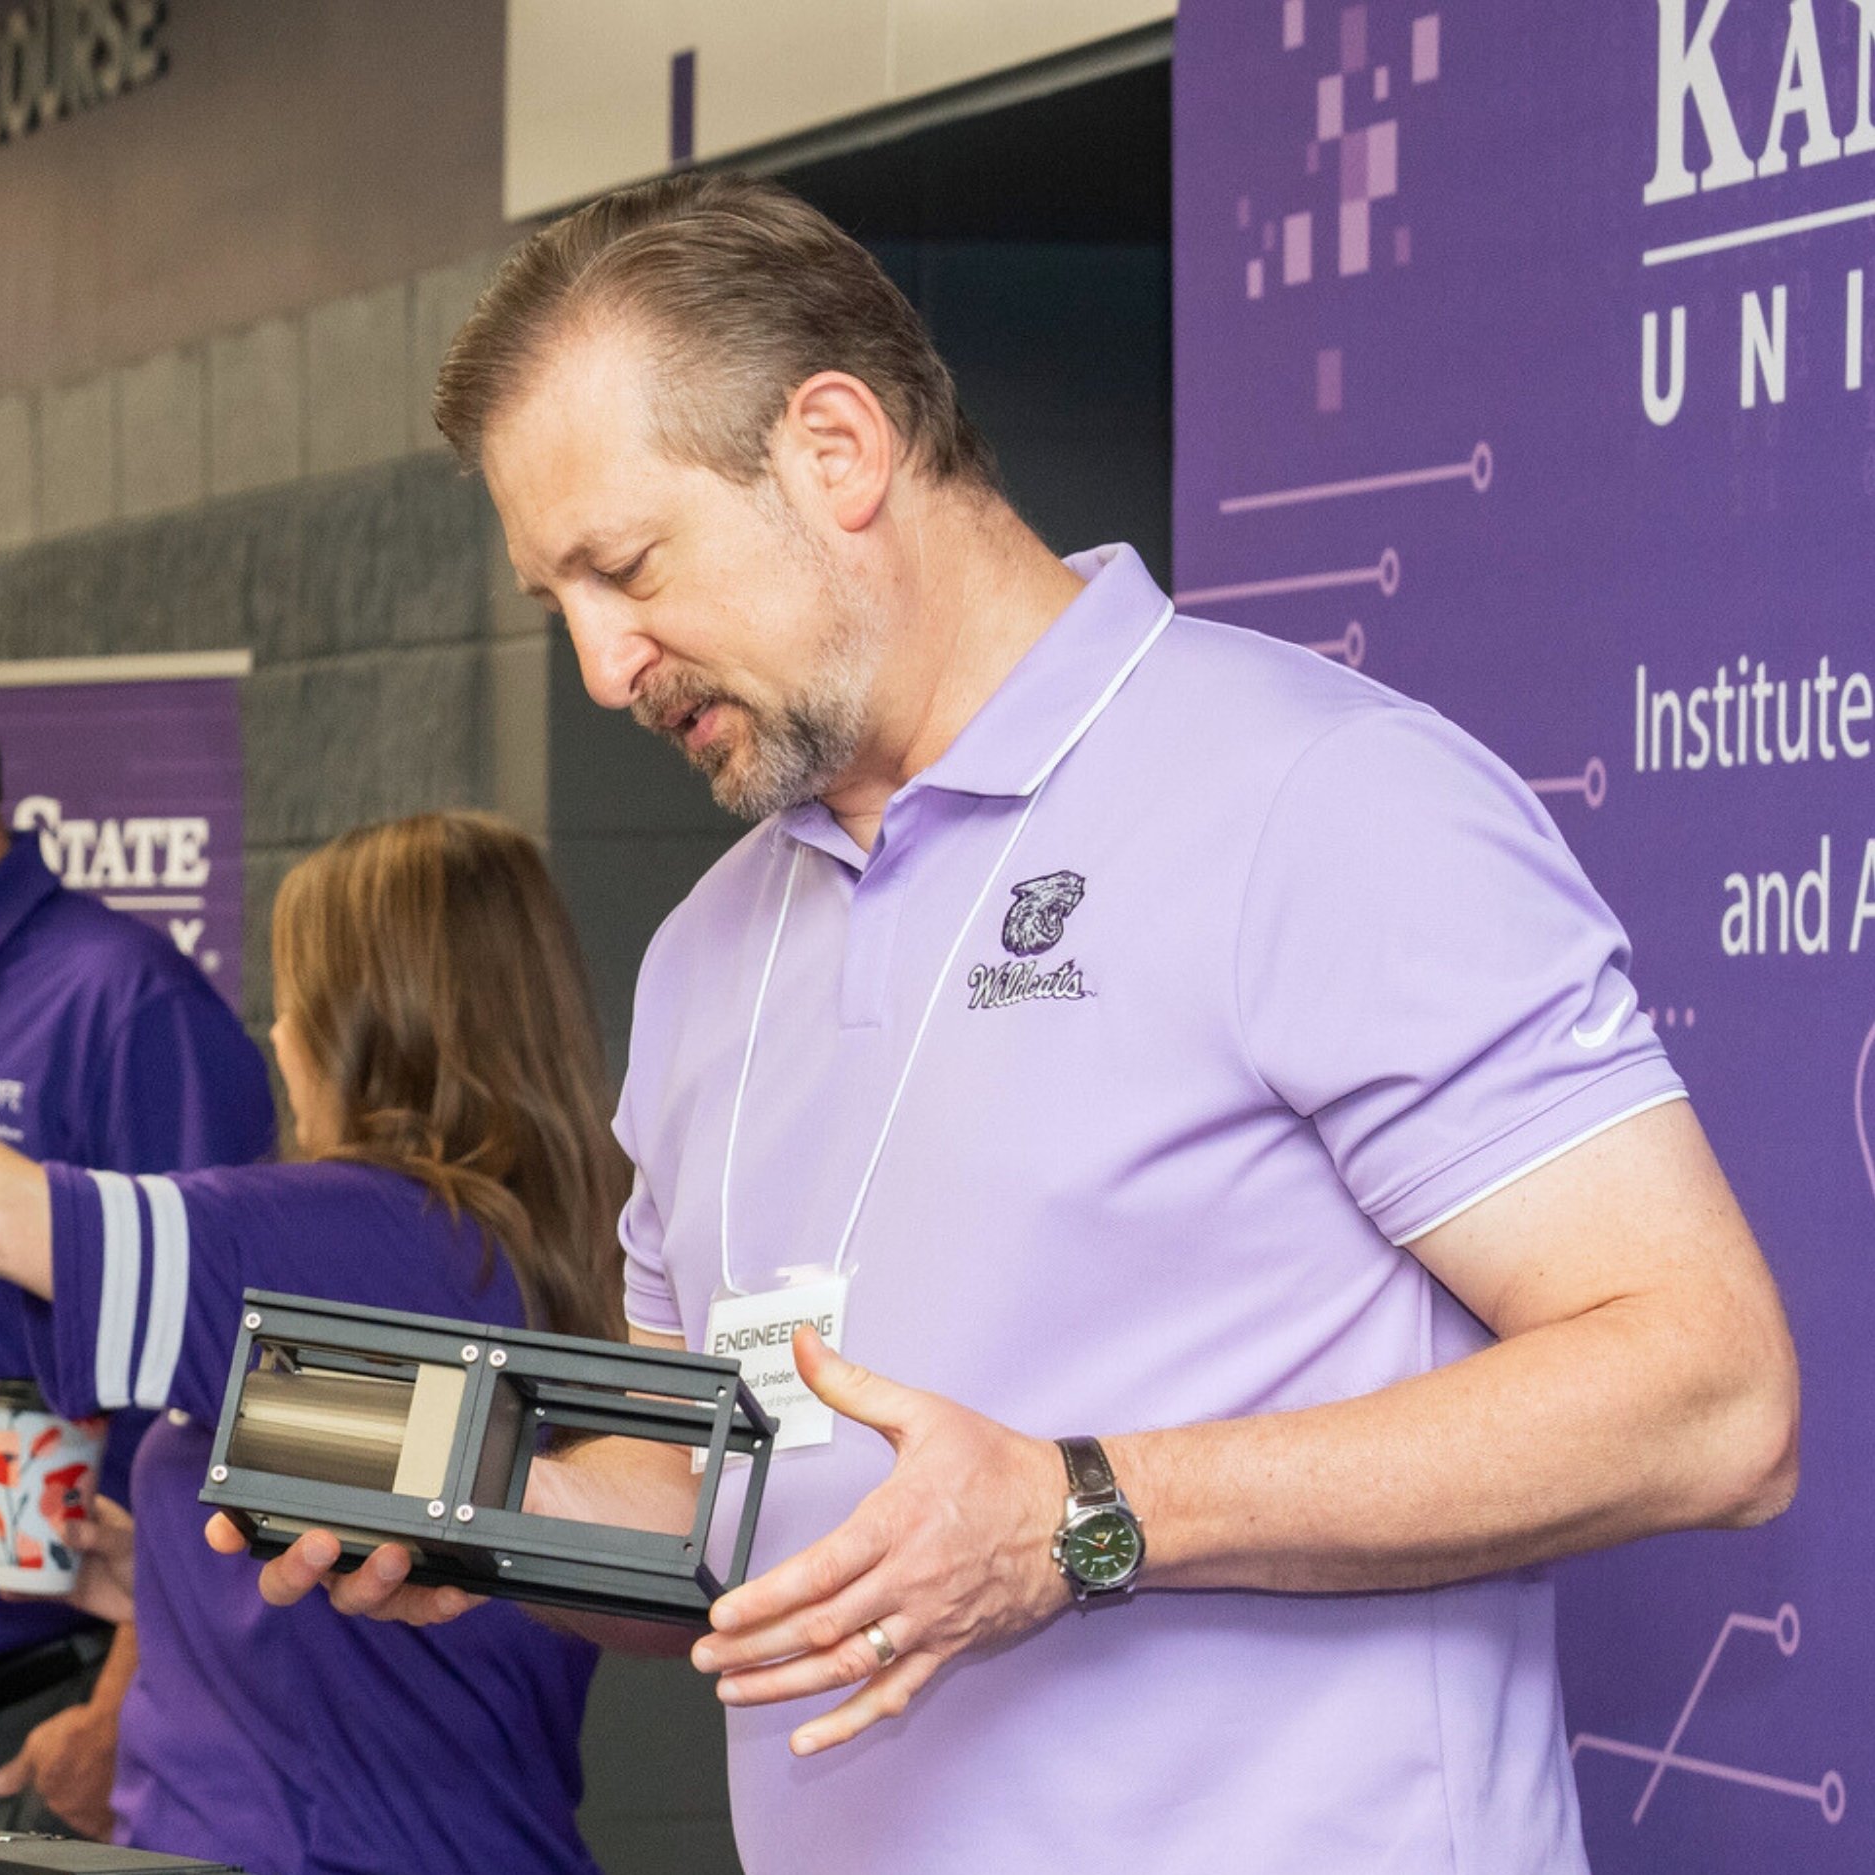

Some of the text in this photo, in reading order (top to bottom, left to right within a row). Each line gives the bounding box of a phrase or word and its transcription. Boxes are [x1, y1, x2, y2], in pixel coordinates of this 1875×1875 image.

[1635, 654, 1874, 772] Institute
[1721, 834, 1830, 957] and
[968, 958, 1087, 1010] Wildcats
